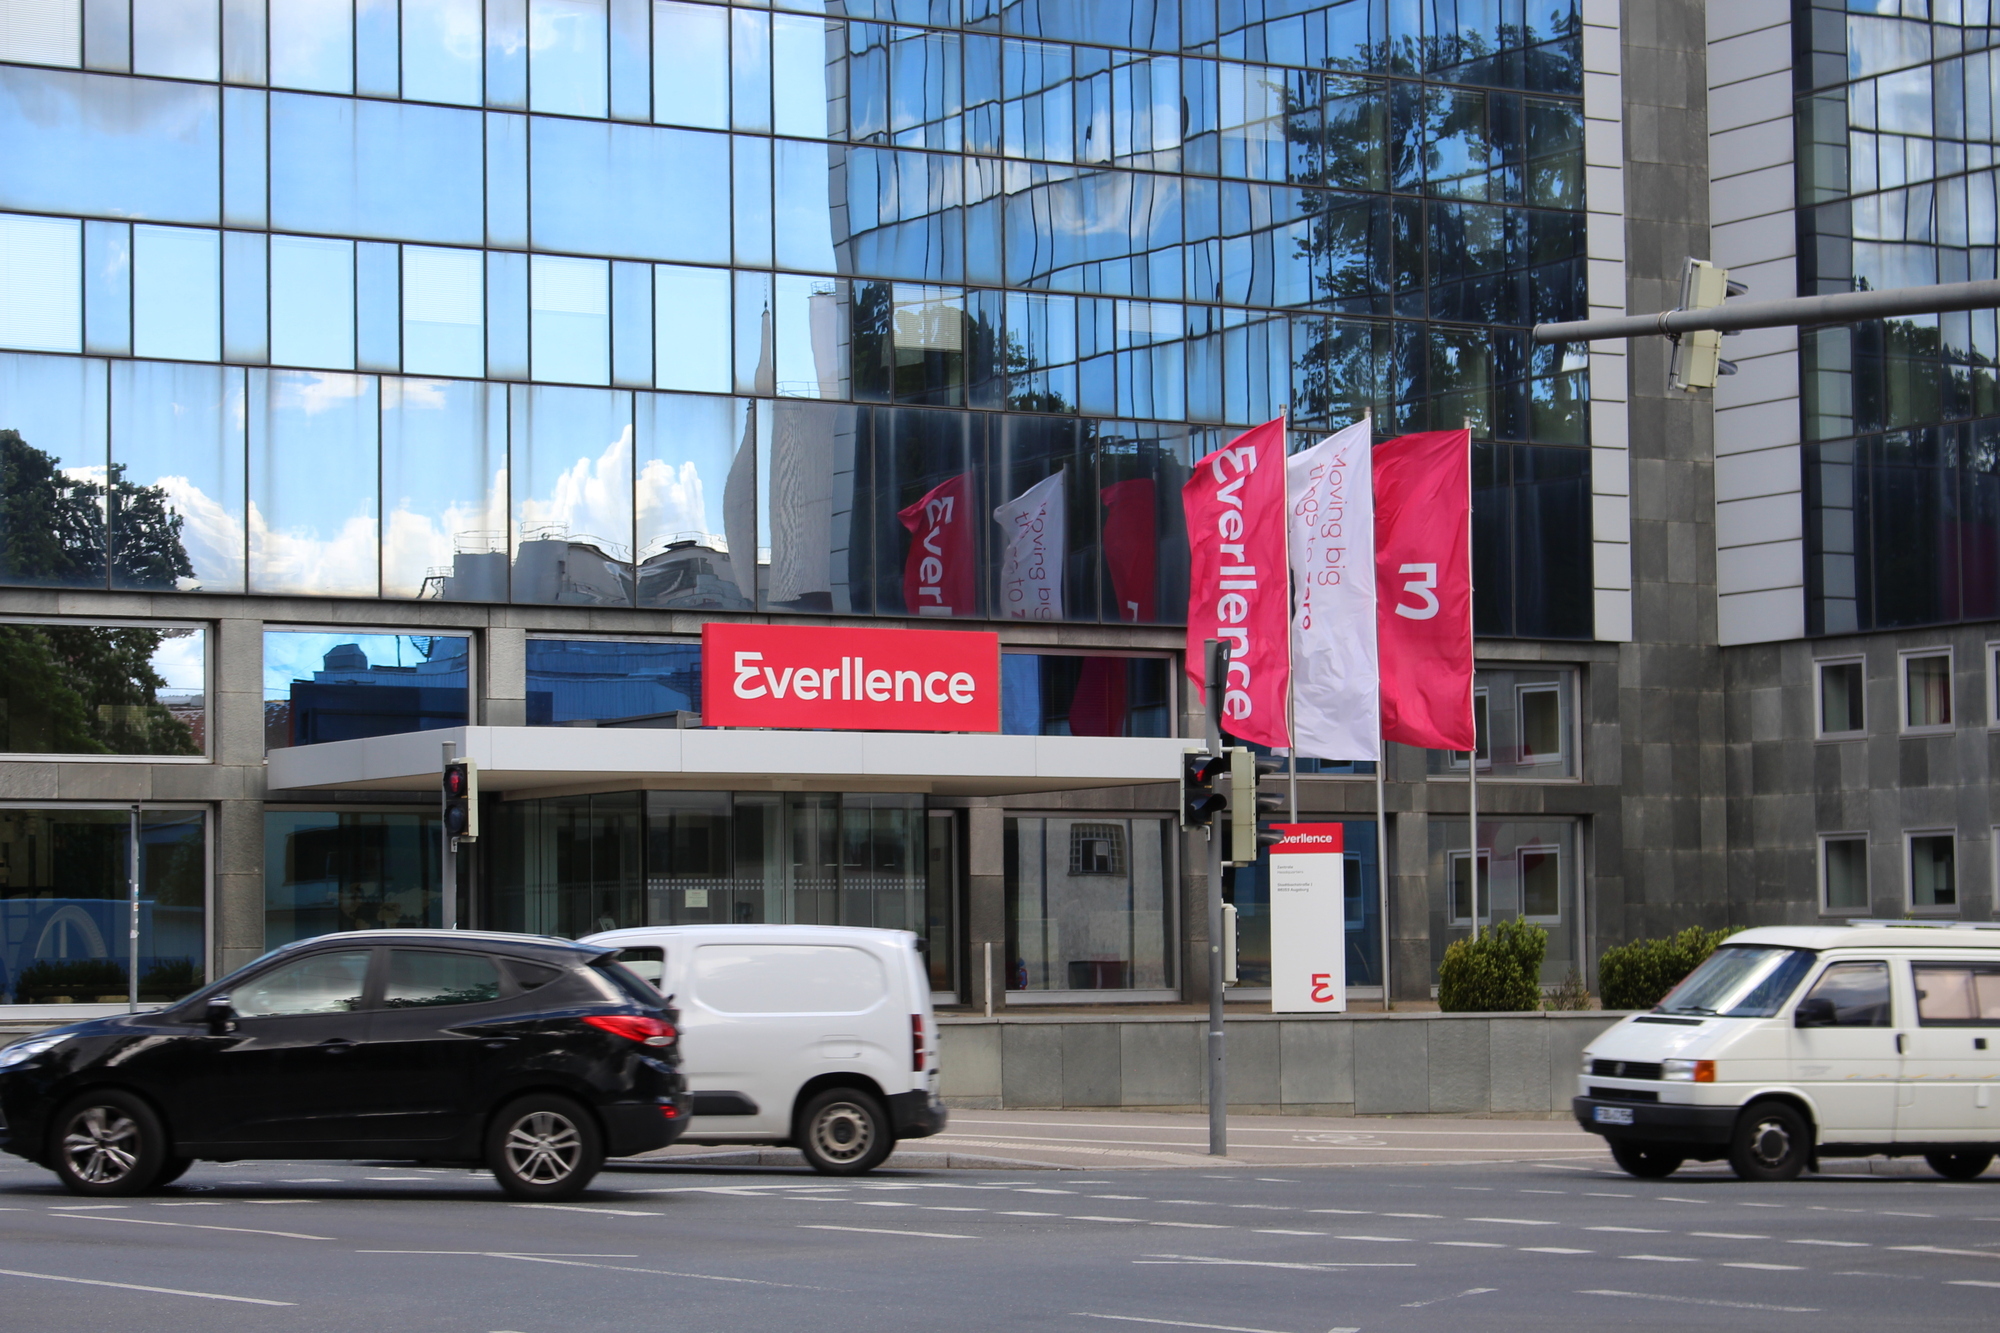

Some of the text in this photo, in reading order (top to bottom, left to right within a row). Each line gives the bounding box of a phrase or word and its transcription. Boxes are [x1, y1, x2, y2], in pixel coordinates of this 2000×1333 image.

[1211, 445, 1257, 720] Everllence
[1317, 547, 1347, 586] big
[733, 651, 976, 705] Everllence
[1279, 833, 1333, 844] verllence
